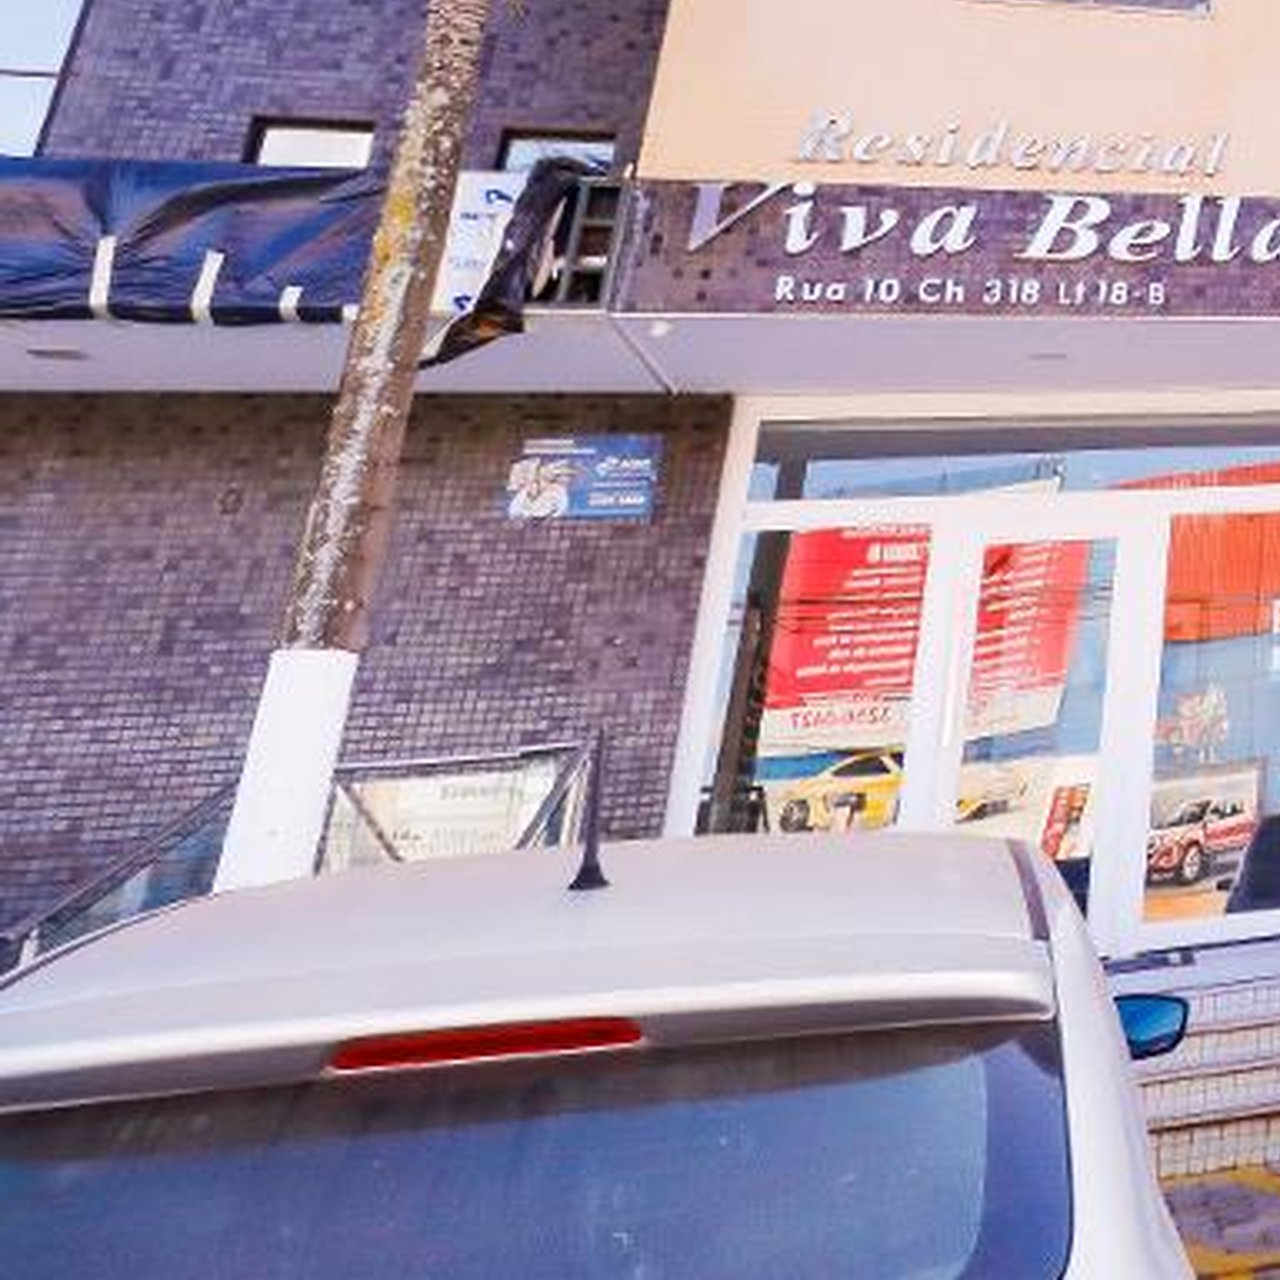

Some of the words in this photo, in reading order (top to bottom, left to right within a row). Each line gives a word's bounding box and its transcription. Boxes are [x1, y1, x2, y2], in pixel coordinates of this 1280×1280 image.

[800, 110, 1231, 176] Residencial
[686, 182, 980, 255] Viva
[774, 275, 847, 302] Rua
[863, 278, 899, 303] 10
[919, 278, 965, 304] Ch
[983, 280, 1040, 305] 318
